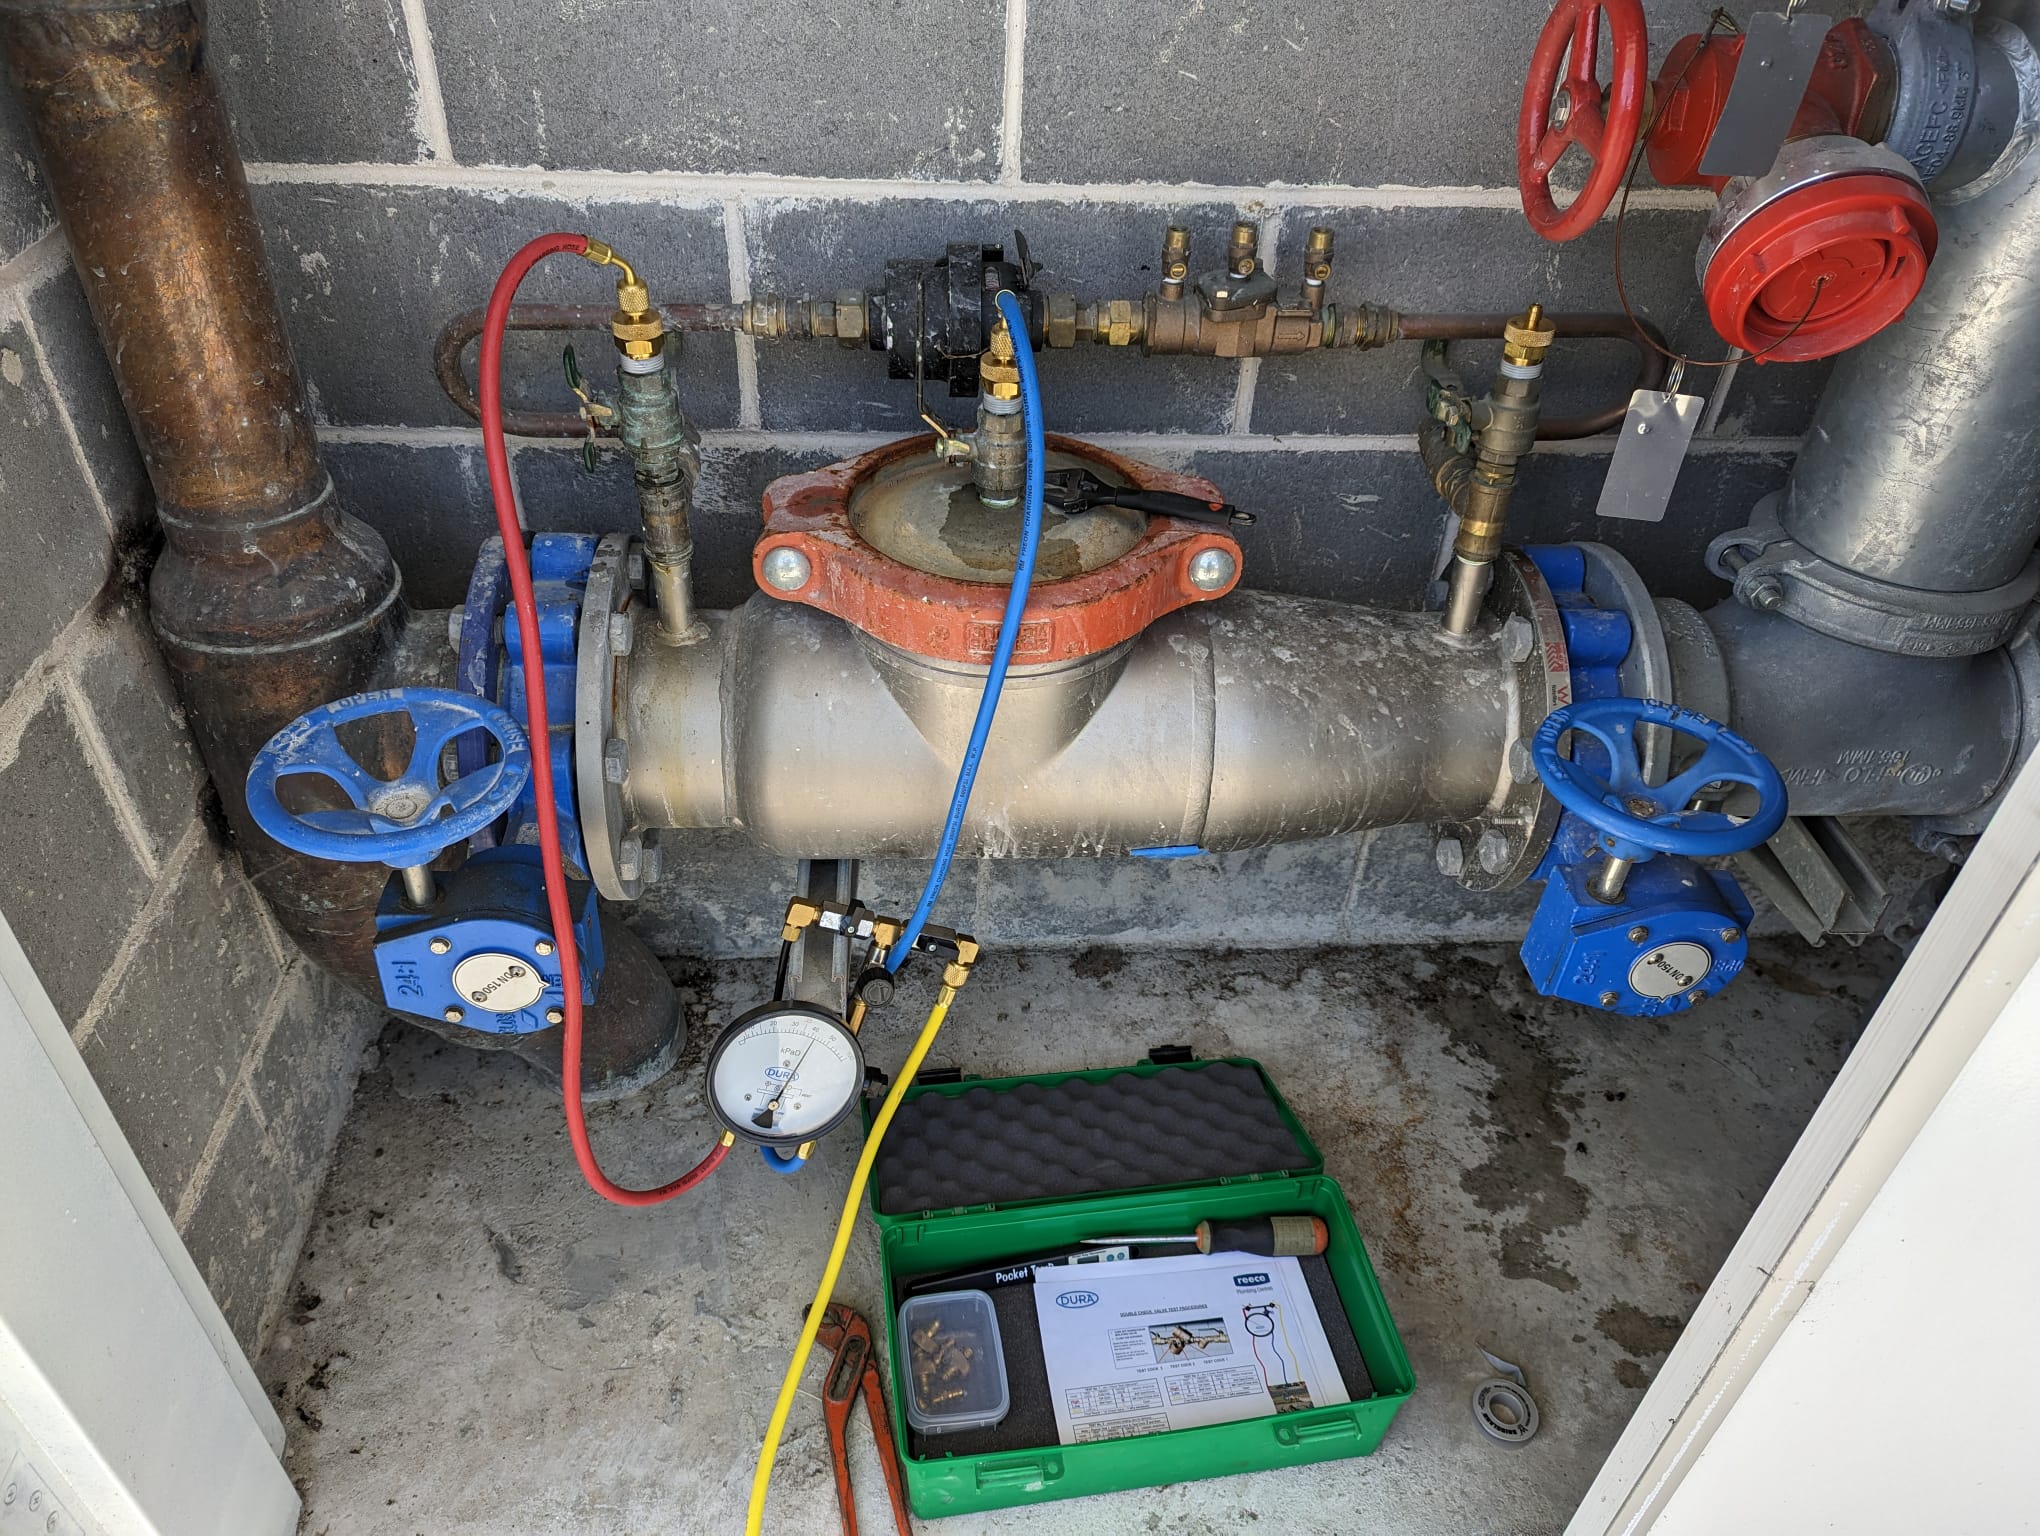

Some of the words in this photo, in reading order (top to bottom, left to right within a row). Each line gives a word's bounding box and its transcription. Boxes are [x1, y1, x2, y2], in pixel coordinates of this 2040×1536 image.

[1024, 486, 1033, 527] CHARGING
[338, 689, 392, 708] OPEN
[1657, 960, 1672, 973] 150
[484, 978, 501, 994] 150
[766, 1068, 798, 1081] DURA
[995, 1267, 1028, 1284] Pocket
[1236, 1275, 1266, 1285] reece
[1059, 1292, 1096, 1306] DURA
